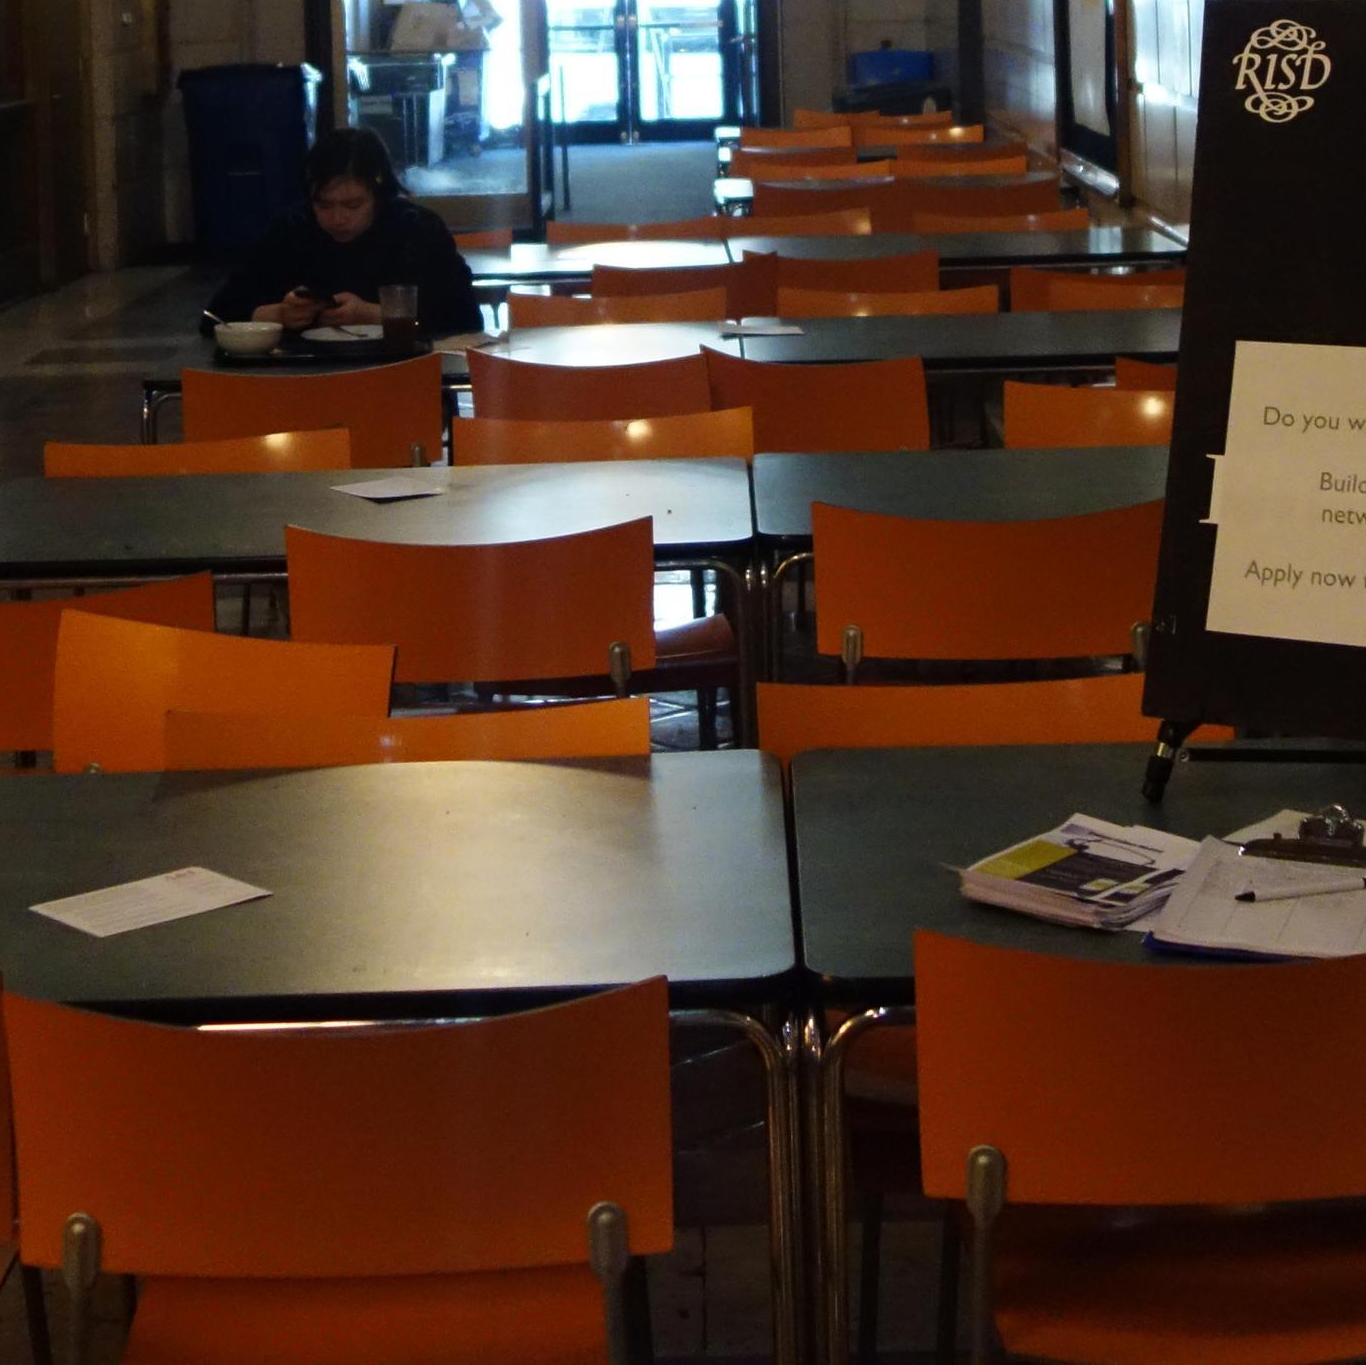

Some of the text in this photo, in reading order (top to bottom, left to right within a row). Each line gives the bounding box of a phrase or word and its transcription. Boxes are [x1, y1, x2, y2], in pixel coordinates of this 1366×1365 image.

[1263, 406, 1295, 427] Do
[1301, 412, 1340, 432] you
[1245, 561, 1303, 587] Apply
[1311, 570, 1356, 587] now
